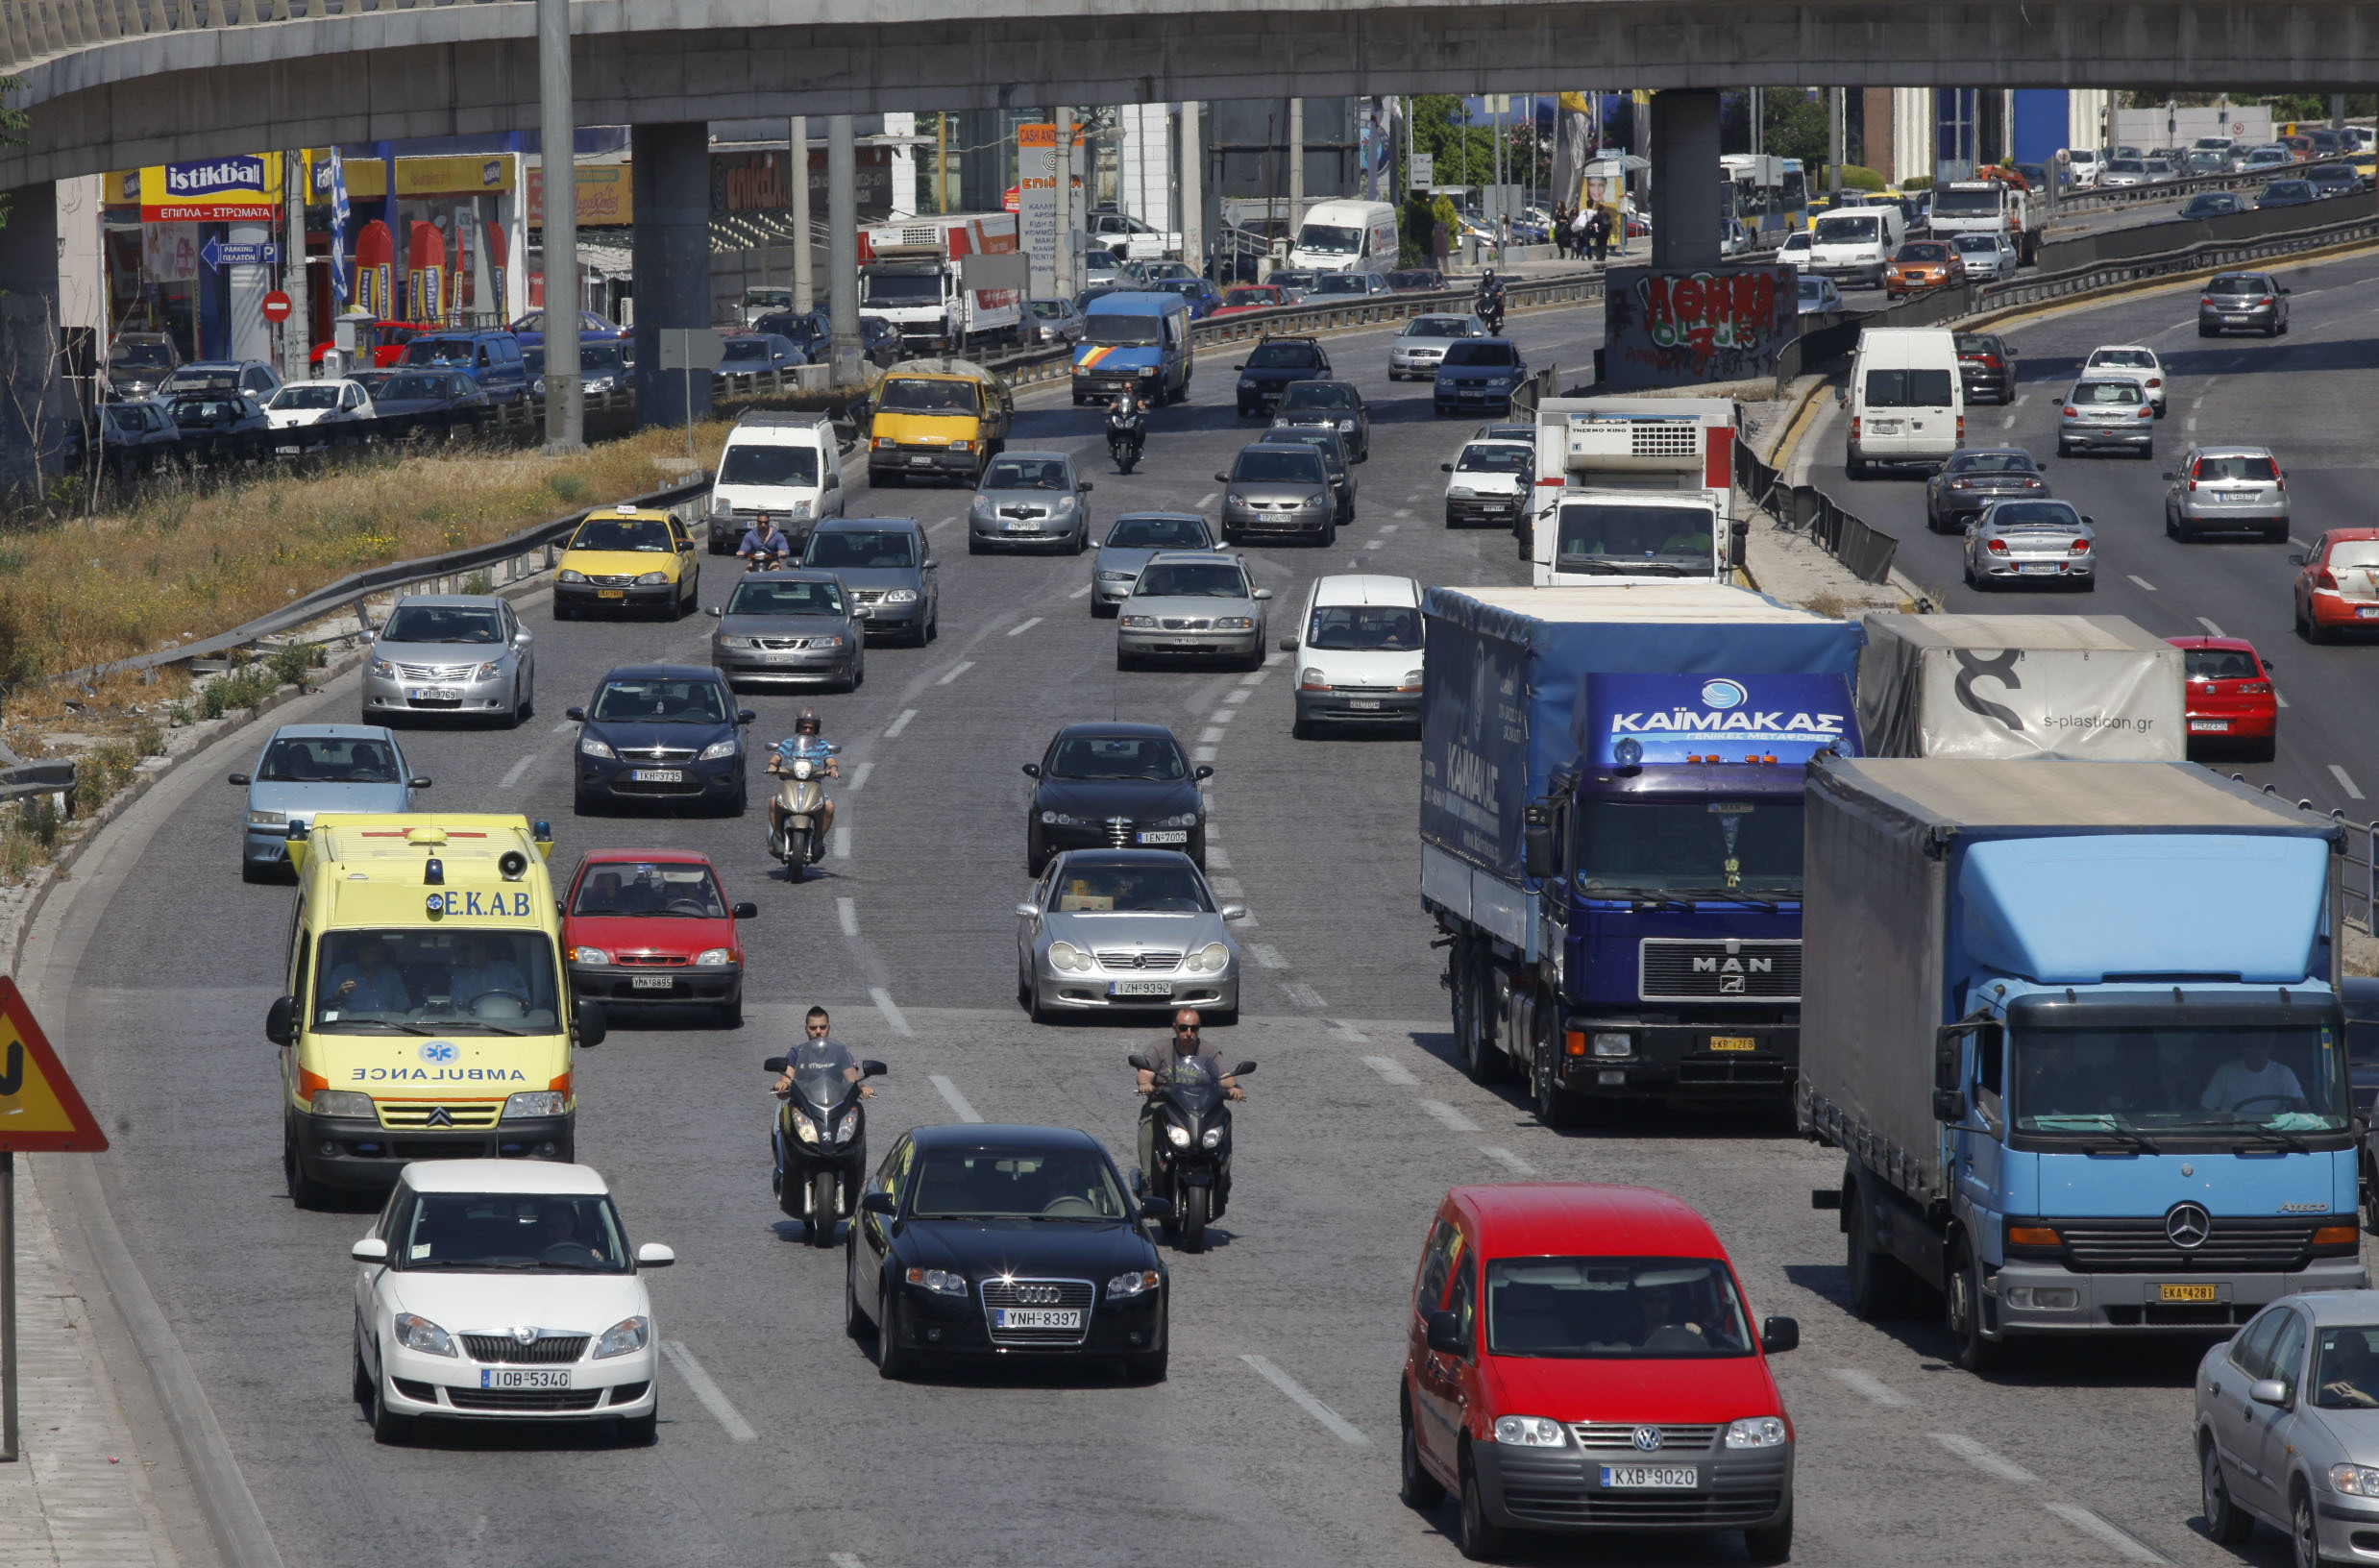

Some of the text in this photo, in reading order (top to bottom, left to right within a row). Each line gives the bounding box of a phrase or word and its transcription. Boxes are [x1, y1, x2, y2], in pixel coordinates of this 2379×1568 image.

[1020, 129, 1039, 142] CASH
[160, 208, 270, 218] ΕΠΙΠΛΑ ΣΤΡΩΜΑΤΑ
[263, 246, 275, 260] P
[1611, 707, 1844, 733] ΚΑΪΜΑΚΑΣ
[2044, 714, 2154, 733] s-plasticon.gr
[1686, 732, 1745, 741] ΓΕΝΙΚΕΣ
[640, 771, 681, 781] IKH-3735
[1145, 832, 1186, 843] IEN-7002
[1693, 957, 1772, 973] MAN
[1120, 983, 1169, 993] IZH-9392
[1010, 1312, 1078, 1326] YNH-8397
[1615, 1469, 1695, 1485] KXB-9020
